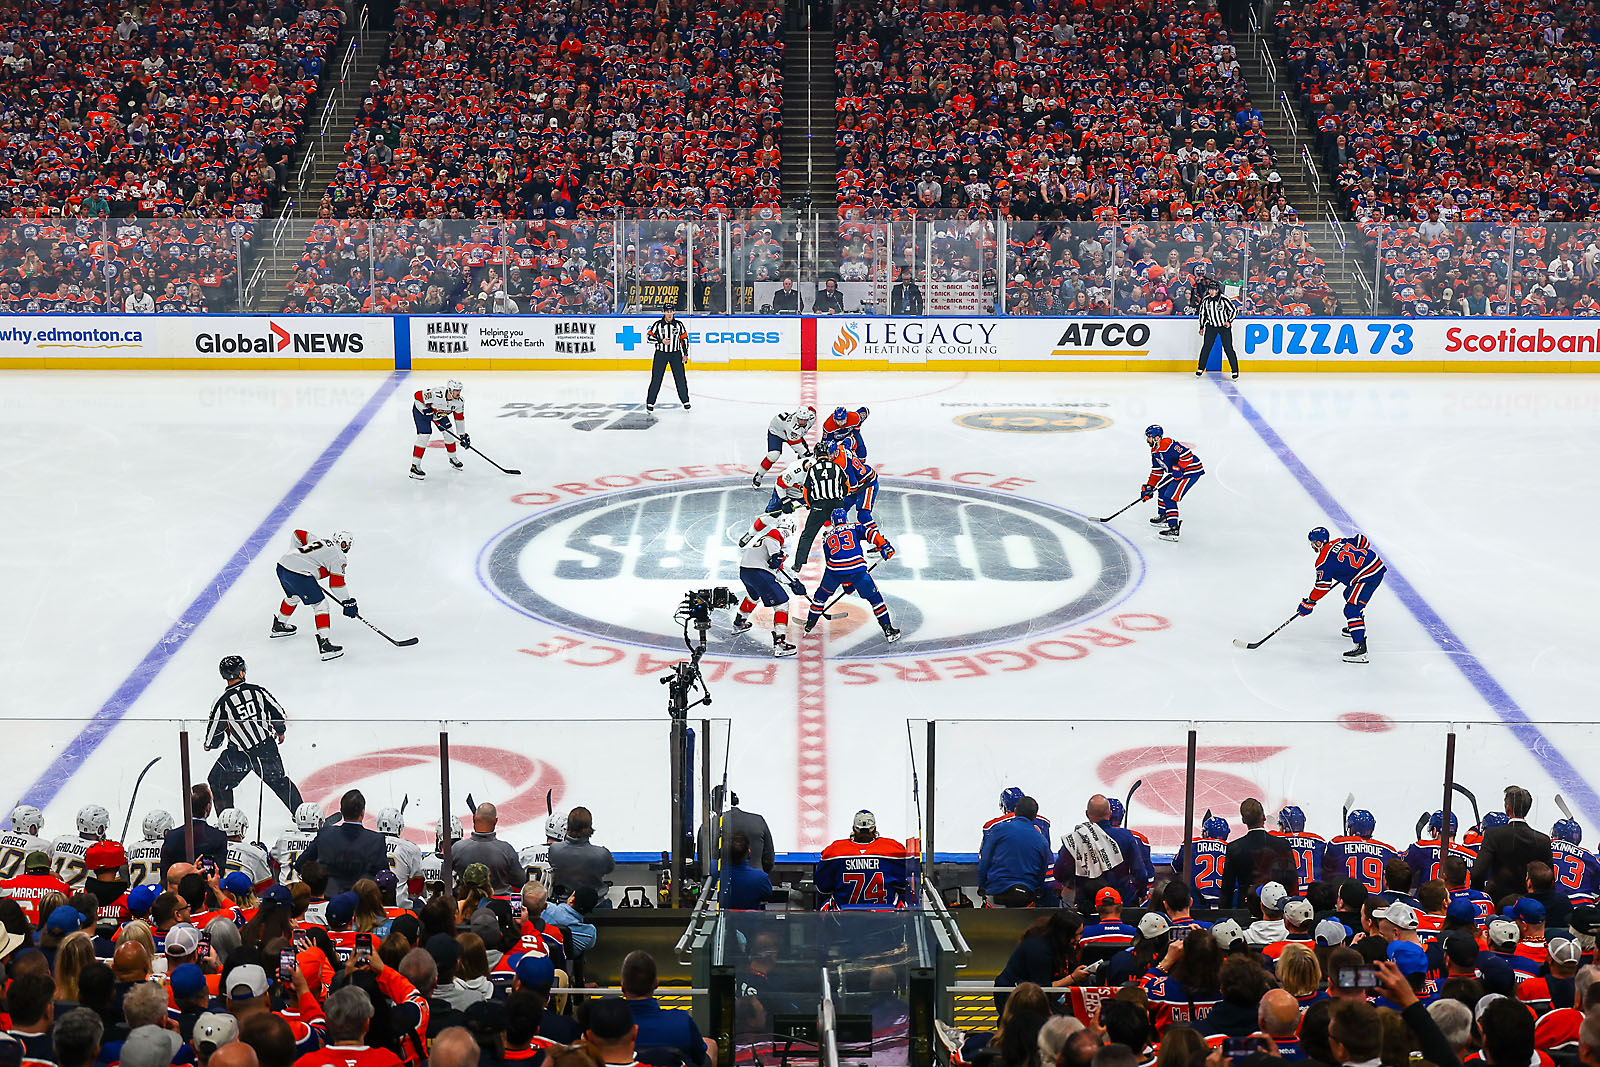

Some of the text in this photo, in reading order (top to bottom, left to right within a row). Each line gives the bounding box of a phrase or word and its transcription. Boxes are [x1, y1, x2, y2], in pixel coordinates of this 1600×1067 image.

[644, 286, 656, 295] TO
[658, 286, 679, 296] YOUR
[629, 296, 678, 304] HPPY PLACE
[0, 327, 143, 344] why.edmonton.ca
[427, 322, 469, 336] HEAVY
[480, 328, 524, 338] Helping you
[554, 322, 596, 336] HEAVY
[864, 323, 998, 345] LEGACY
[1057, 323, 1150, 346] ATCO
[195, 333, 364, 353] Global NEWS
[480, 338, 544, 347] MOVE the Earth
[706, 332, 780, 344] CROSS
[1244, 324, 1414, 355] PIZZA 73
[427, 340, 469, 354] METAL
[554, 341, 596, 354] METAL
[864, 346, 998, 354] HEATING & COOLING
[821, 468, 828, 480] 4
[874, 463, 1036, 490] LACE
[827, 530, 856, 556] 93
[1337, 542, 1368, 568] 27
[236, 700, 257, 720] 50
[1, 835, 28, 848] GREER
[288, 840, 311, 850] REINH
[1197, 842, 1227, 853] DRAISAI
[1288, 838, 1316, 850] EDERIC
[55, 842, 87, 858] GADJOV
[129, 848, 160, 860] LUOSTAR
[1344, 844, 1384, 858] HENRIQUE
[1550, 842, 1584, 858] SKINNER
[0, 846, 26, 880] 0
[535, 853, 550, 862] NOS
[846, 858, 880, 870] SKINNER
[1346, 856, 1384, 896] 19
[12, 888, 60, 898] MARCHA
[842, 872, 887, 904] 74
[97, 906, 121, 918] CHUK
[521, 934, 538, 949] 19
